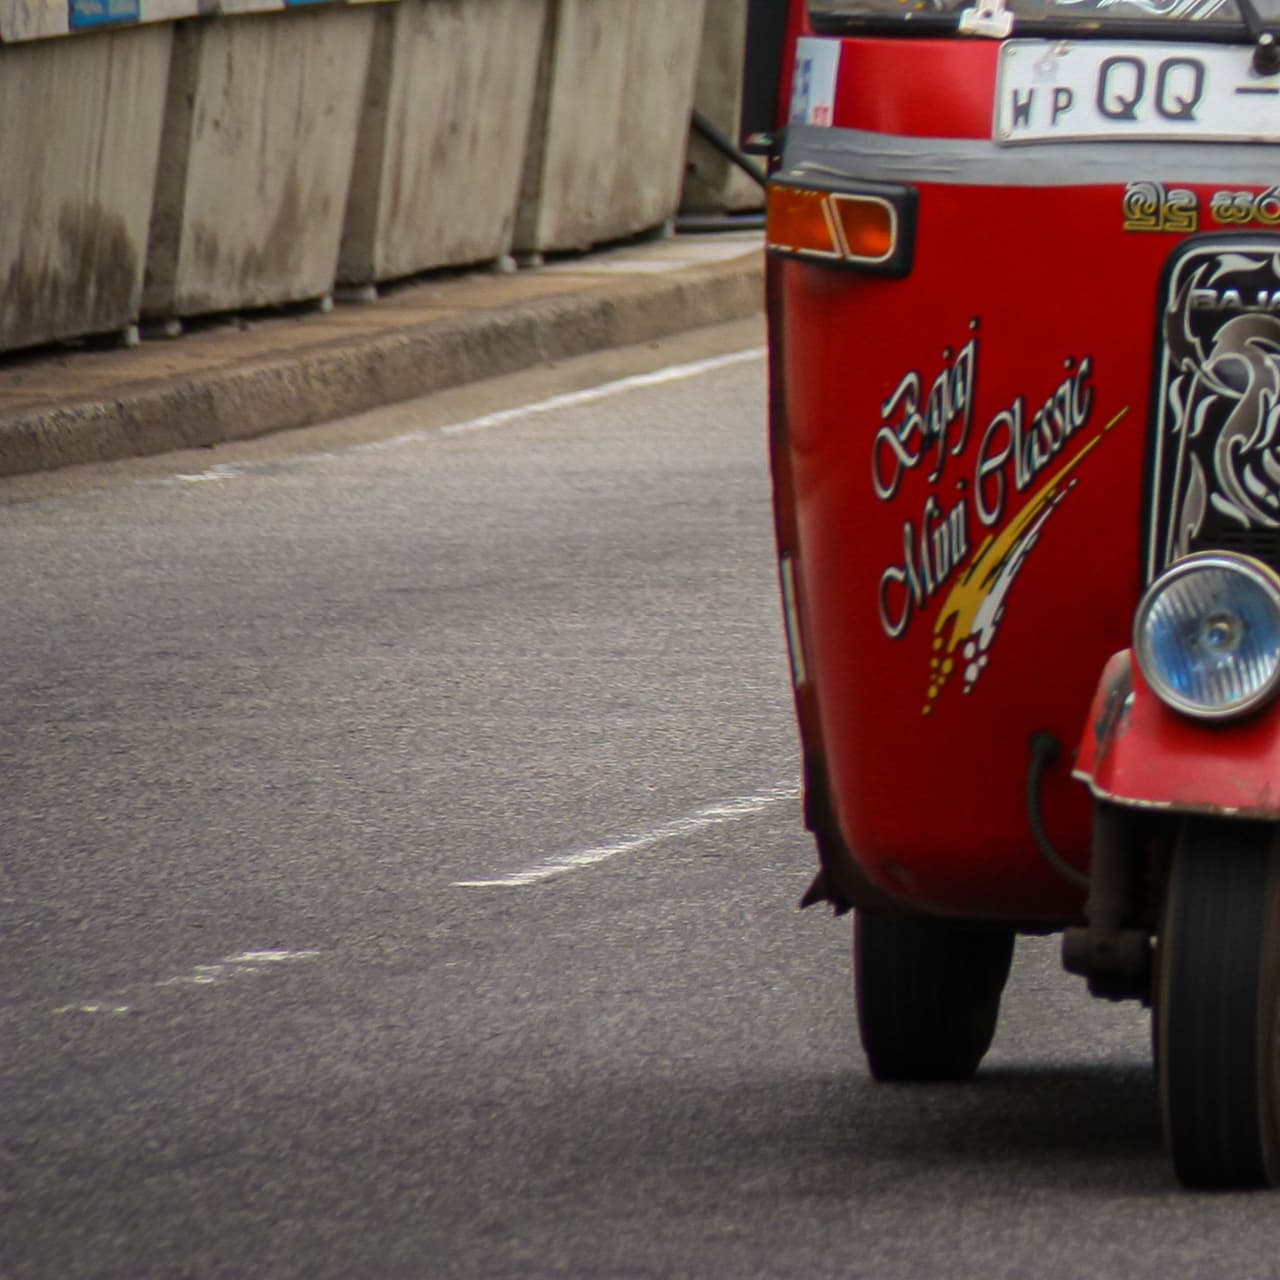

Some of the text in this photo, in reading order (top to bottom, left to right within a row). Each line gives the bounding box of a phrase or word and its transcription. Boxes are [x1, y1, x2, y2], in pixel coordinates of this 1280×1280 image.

[1097, 55, 1206, 121] QQ
[872, 317, 979, 500] Bajaj
[879, 356, 1092, 638] Mini Classic
